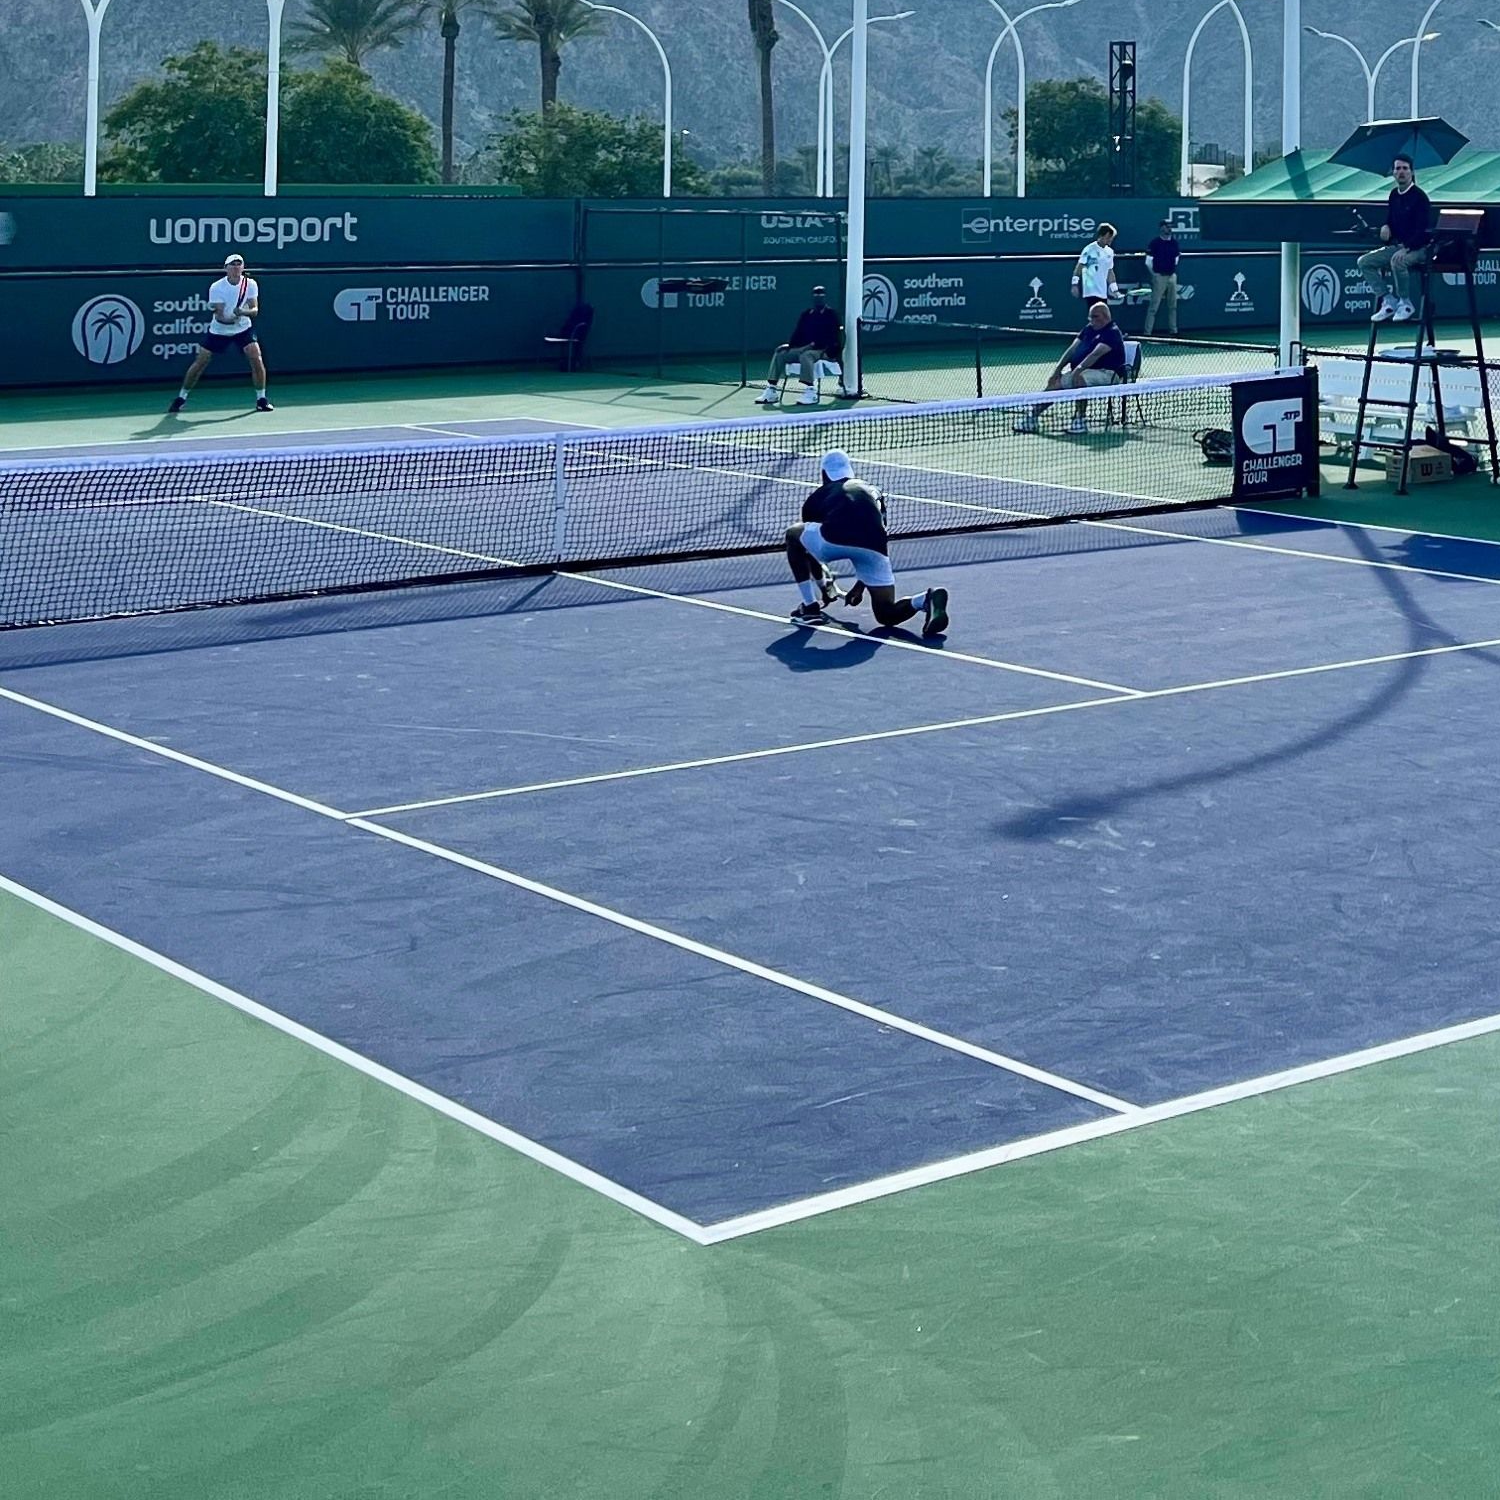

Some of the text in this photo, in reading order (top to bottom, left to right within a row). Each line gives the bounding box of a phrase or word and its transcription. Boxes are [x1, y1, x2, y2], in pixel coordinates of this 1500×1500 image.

[150, 212, 358, 250] uomosport
[970, 214, 1096, 236] enterprise
[903, 273, 963, 289] southern
[1472, 272, 1497, 285] TOUR
[153, 293, 216, 312] southe
[386, 286, 489, 303] CHALLENGER
[686, 292, 725, 308] TOUR
[903, 291, 966, 308] california
[386, 304, 430, 320] TOUR
[1344, 300, 1371, 313] open
[152, 316, 210, 335] califor
[152, 343, 200, 360] open
[1242, 454, 1303, 472] CHALLENGER
[1242, 471, 1268, 485] TOUR
